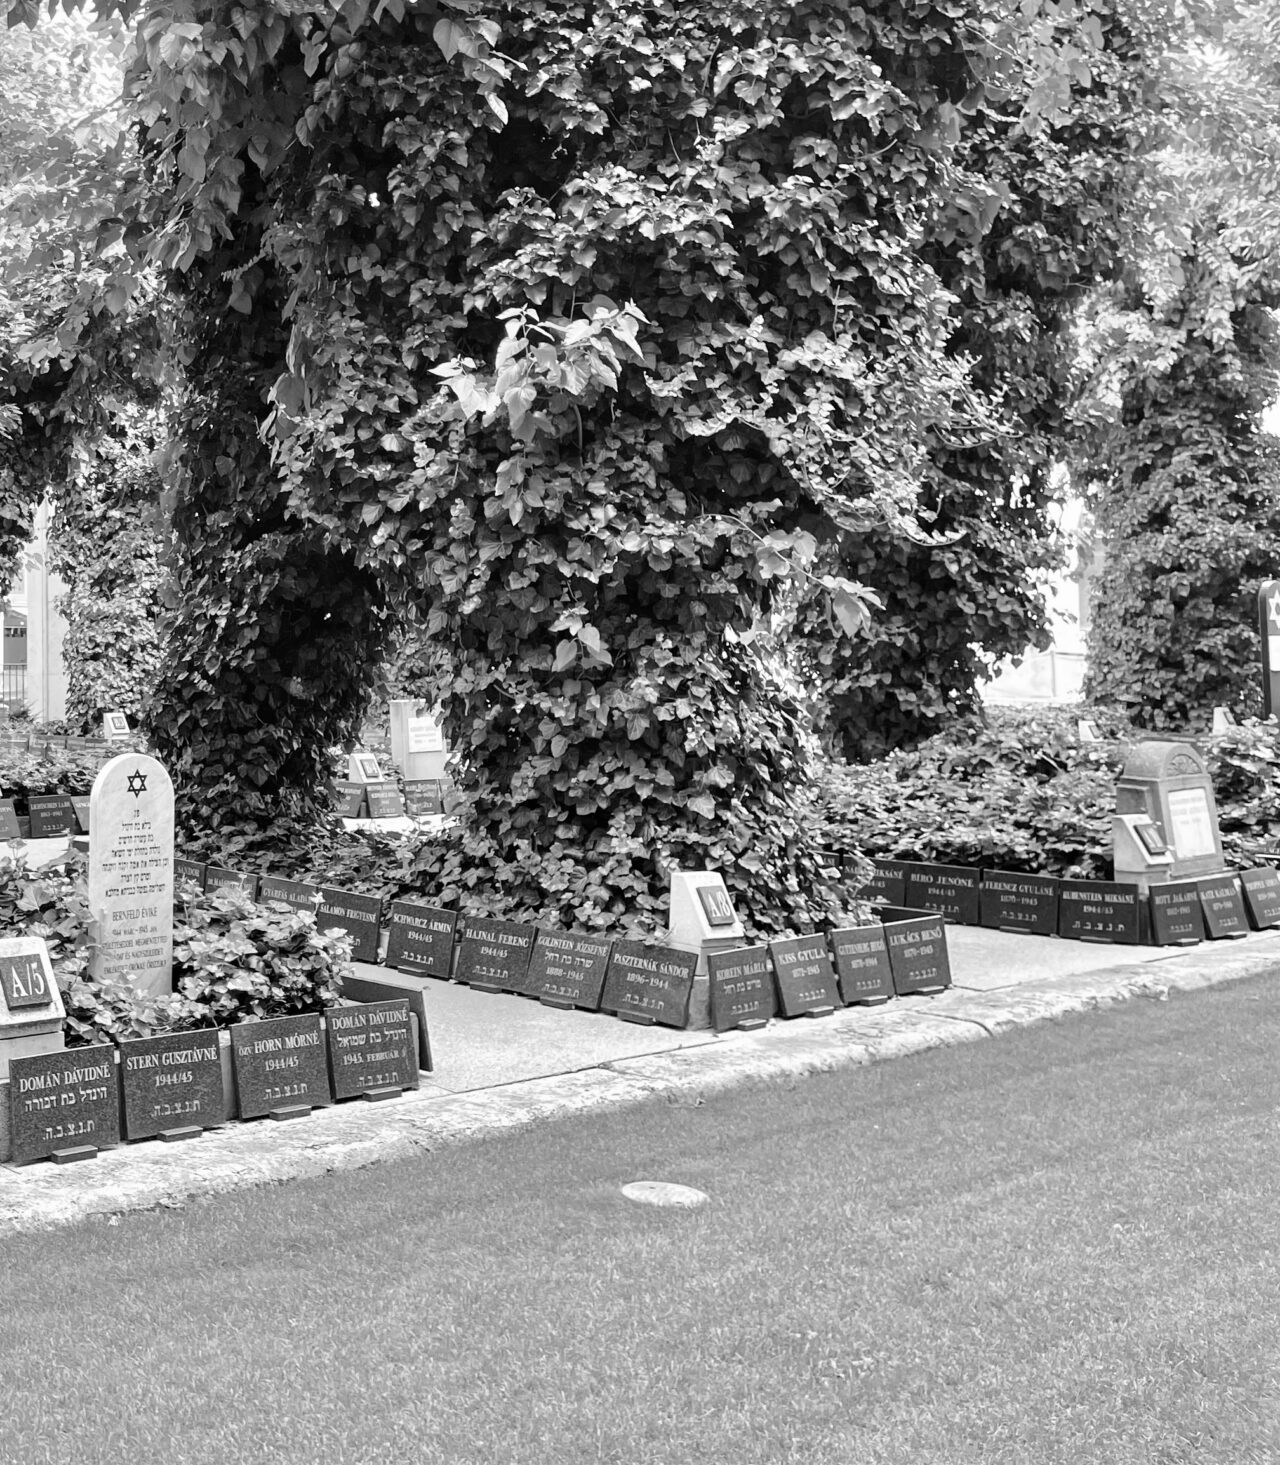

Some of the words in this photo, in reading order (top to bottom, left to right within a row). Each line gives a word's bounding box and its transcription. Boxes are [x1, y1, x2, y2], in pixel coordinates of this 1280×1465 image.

[911, 872, 933, 883] BÍRÓ
[936, 874, 974, 887] JENŐNÉ
[985, 880, 1017, 892] FERENCZ
[1019, 881, 1054, 896] GYULÁNÉ
[263, 887, 288, 900] GYÁRFÁS
[321, 904, 345, 918] SALAMON
[393, 913, 427, 929] SCHWARCZ
[429, 917, 452, 934] ÁRMIN
[407, 932, 433, 943] 1944/45
[466, 928, 496, 942] HAJNAL
[498, 934, 529, 948] FERENC
[890, 931, 920, 946] LUKÁCS
[921, 926, 942, 941] BENŐ
[480, 946, 508, 958] 1944/45
[538, 936, 573, 951] GOLDSTEIN
[575, 941, 608, 957] JÓZSEFNÉ
[779, 953, 796, 965] KISS
[797, 948, 825, 961] GYULA
[613, 953, 657, 972] PASZTERNÁK
[659, 961, 689, 979] SÁNDOR
[743, 961, 766, 975] MÁRIA
[11, 963, 45, 998] A/5
[626, 972, 669, 990] 1896-1944
[332, 1012, 367, 1031] DOMÁN
[369, 1007, 409, 1026] DÁVIDNÉ
[254, 1037, 282, 1054] HORN
[285, 1031, 320, 1050] MÓRNÉ
[127, 1054, 159, 1070] STERN
[162, 1045, 217, 1066] GUSZTÁVNÉ
[264, 1056, 299, 1072] 1944/45
[366, 1050, 400, 1063] FEBRUÁR
[19, 1071, 62, 1092] DOMÁN
[64, 1062, 111, 1084] DÁVIDNÉ
[155, 1071, 193, 1087] 1944/45
[79, 1086, 107, 1103] הינדל
